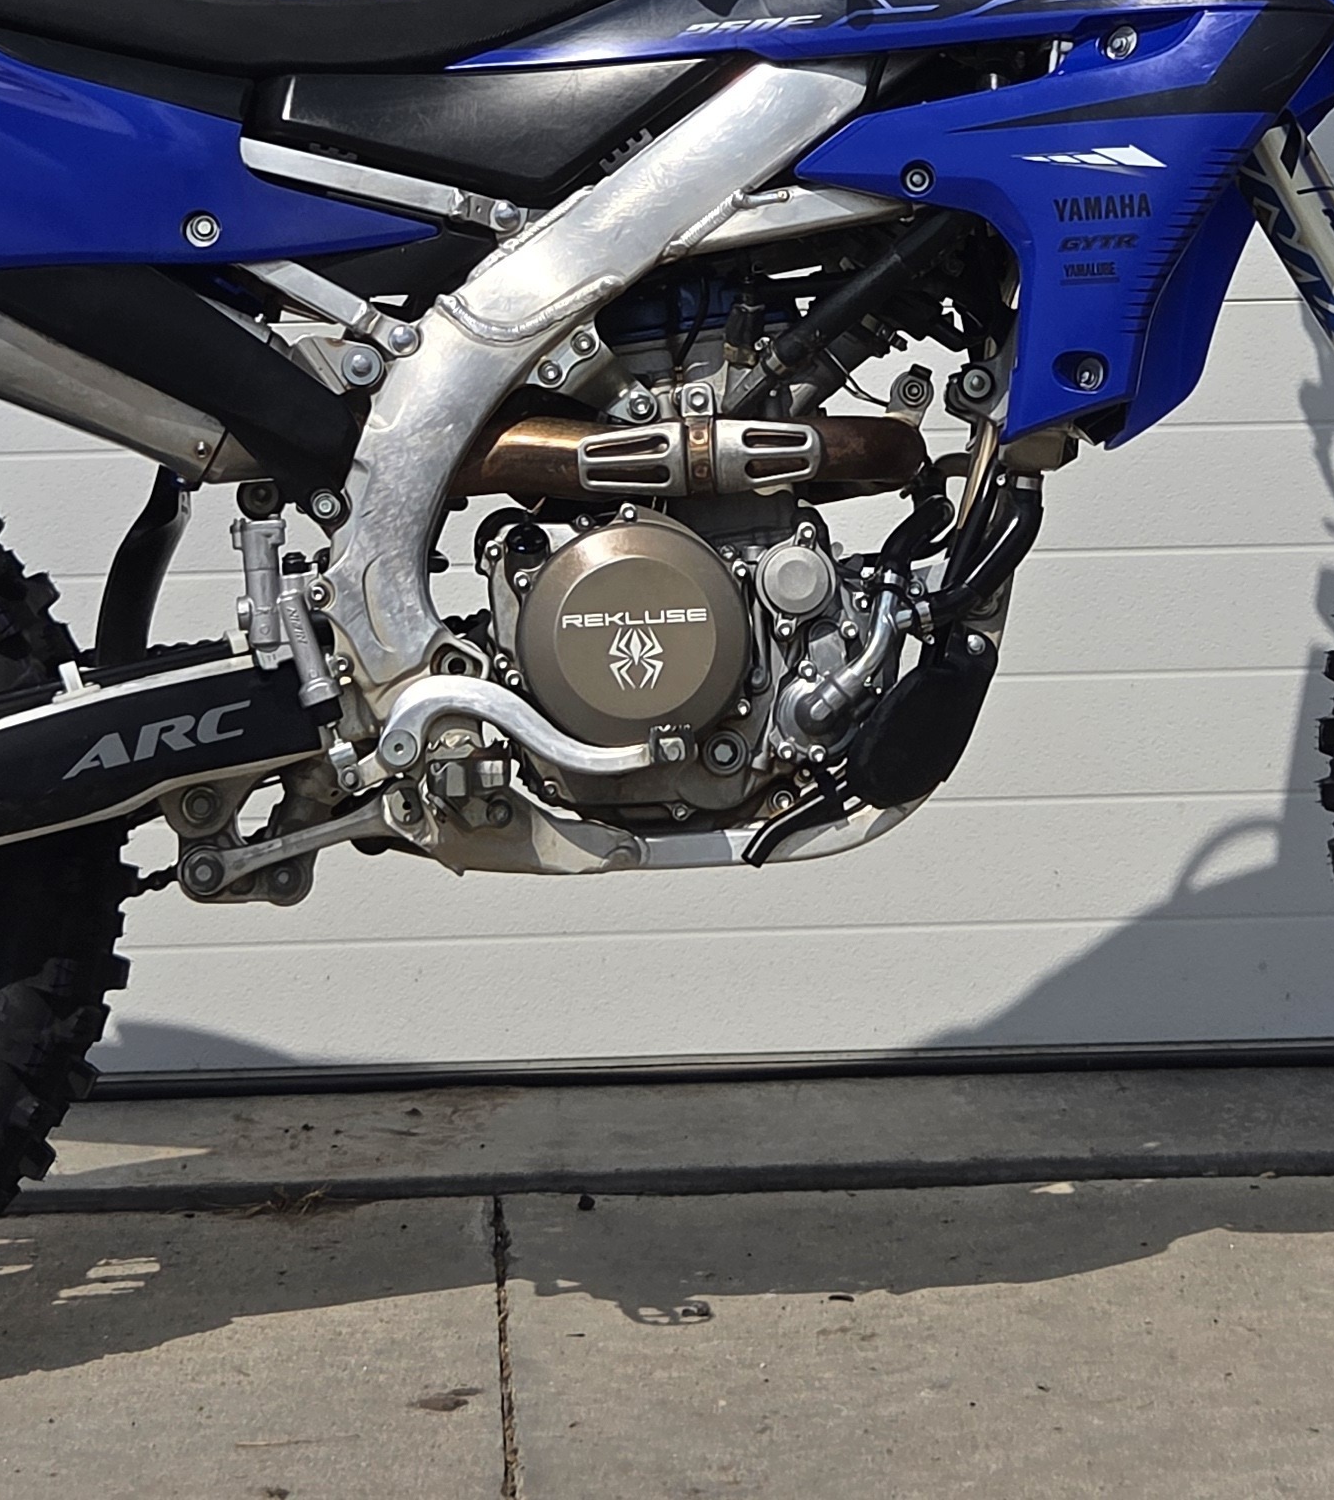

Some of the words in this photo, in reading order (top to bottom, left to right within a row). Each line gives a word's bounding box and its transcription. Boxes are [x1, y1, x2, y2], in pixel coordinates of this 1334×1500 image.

[1053, 192, 1152, 223] YAMAHA
[1057, 232, 1140, 253] GYTR
[562, 607, 708, 630] REKLUSE
[63, 700, 251, 781] ARC
